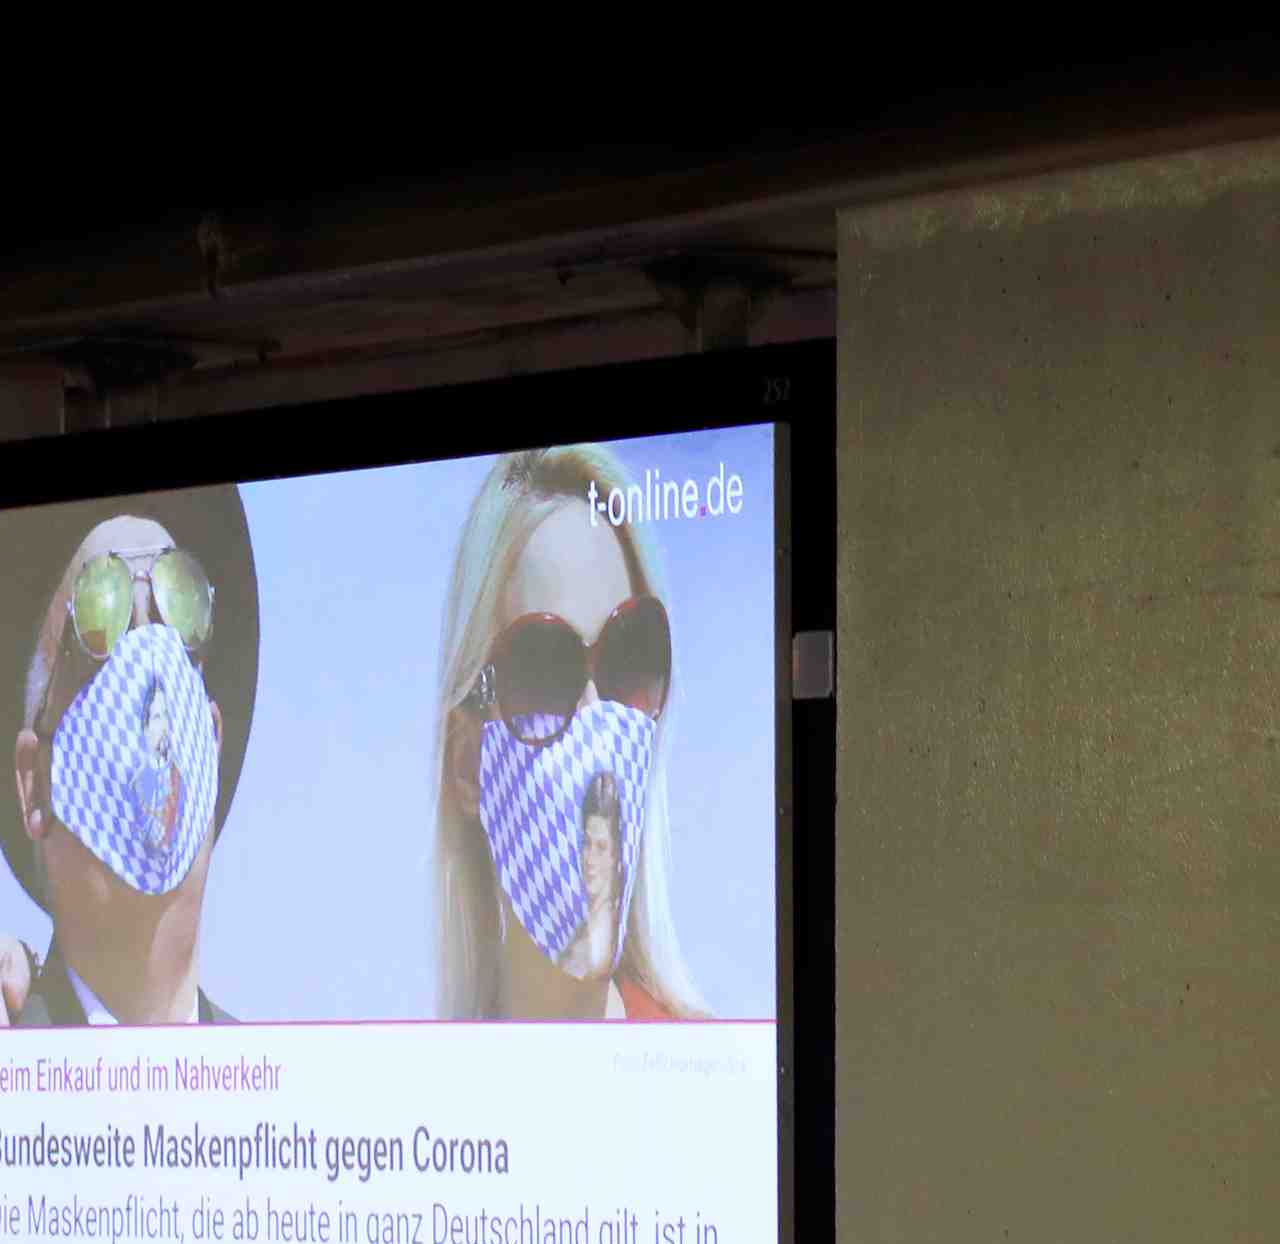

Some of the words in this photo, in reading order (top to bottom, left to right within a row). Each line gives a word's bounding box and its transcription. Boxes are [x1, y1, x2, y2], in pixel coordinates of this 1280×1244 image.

[588, 462, 743, 526] t-online.de
[37, 1056, 102, 1092] Einkauf
[108, 1056, 140, 1091] und
[147, 1058, 168, 1090] im
[176, 1056, 280, 1091] Nahverkehr
[144, 1122, 317, 1181] Maskenpflicht
[325, 1136, 403, 1183] gegen
[413, 1126, 509, 1174] Corona
[192, 1196, 224, 1240] die
[233, 1197, 259, 1240] ab
[267, 1197, 330, 1243] heute
[339, 1200, 357, 1243] in
